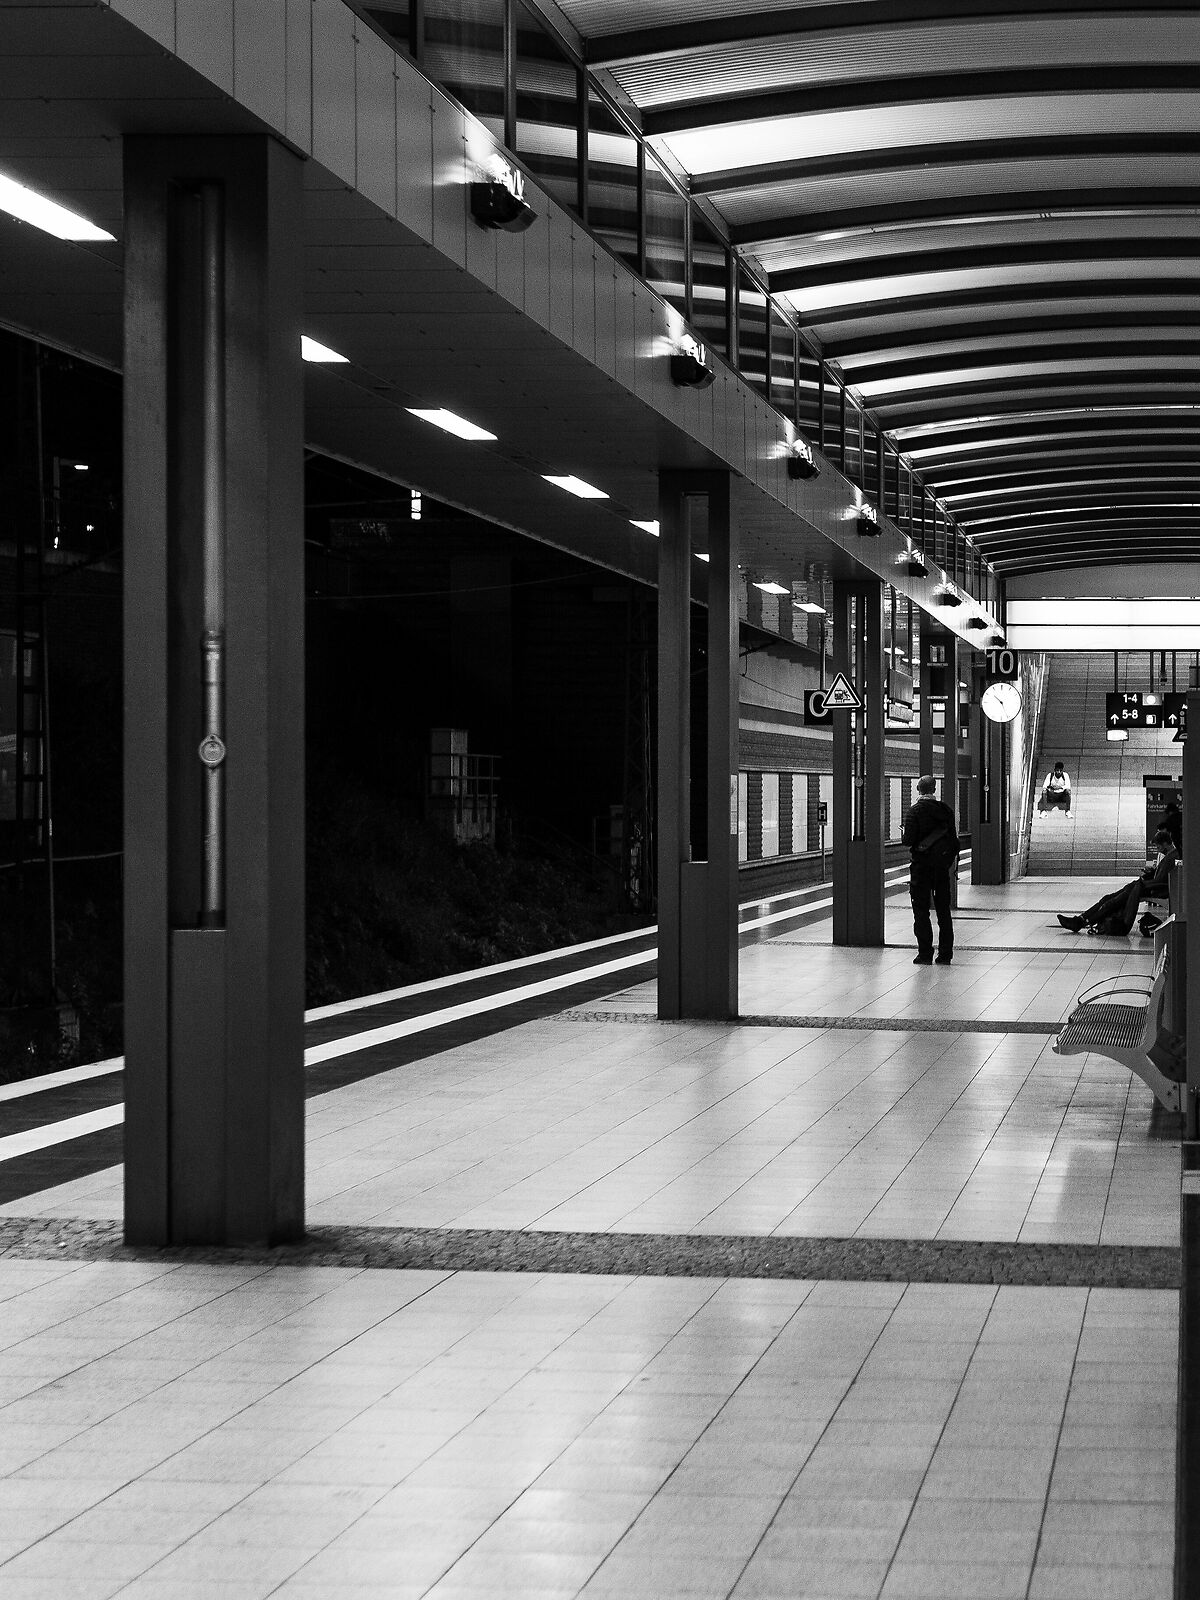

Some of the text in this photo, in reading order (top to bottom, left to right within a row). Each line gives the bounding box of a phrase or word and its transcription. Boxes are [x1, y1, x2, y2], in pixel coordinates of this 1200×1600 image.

[986, 650, 1014, 674] 10
[1123, 694, 1137, 703] 1-4
[1122, 709, 1138, 719] 5-8
[818, 809, 826, 820] H
